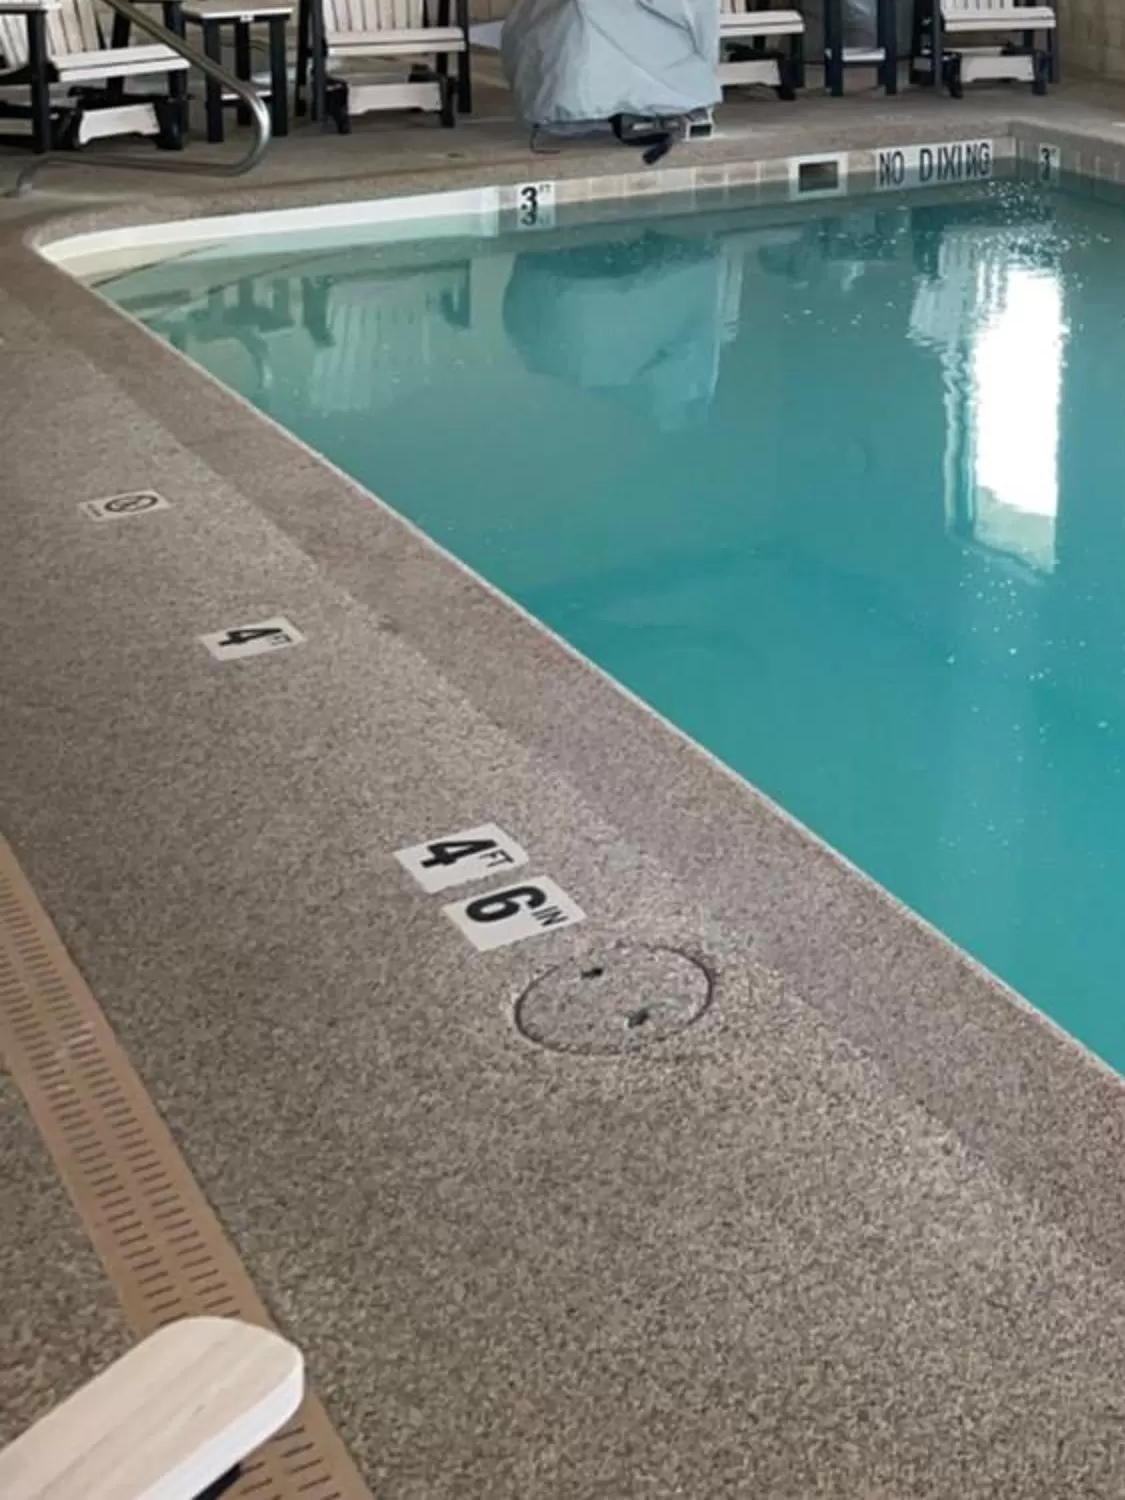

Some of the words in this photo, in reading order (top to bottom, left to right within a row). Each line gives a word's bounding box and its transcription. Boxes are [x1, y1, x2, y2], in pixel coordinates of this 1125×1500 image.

[879, 150, 905, 186] NO
[521, 186, 538, 211] 3
[218, 627, 283, 647] 4
[420, 839, 497, 869] 4
[479, 849, 515, 868] FT
[465, 885, 547, 924] 6
[531, 905, 568, 927] IN
